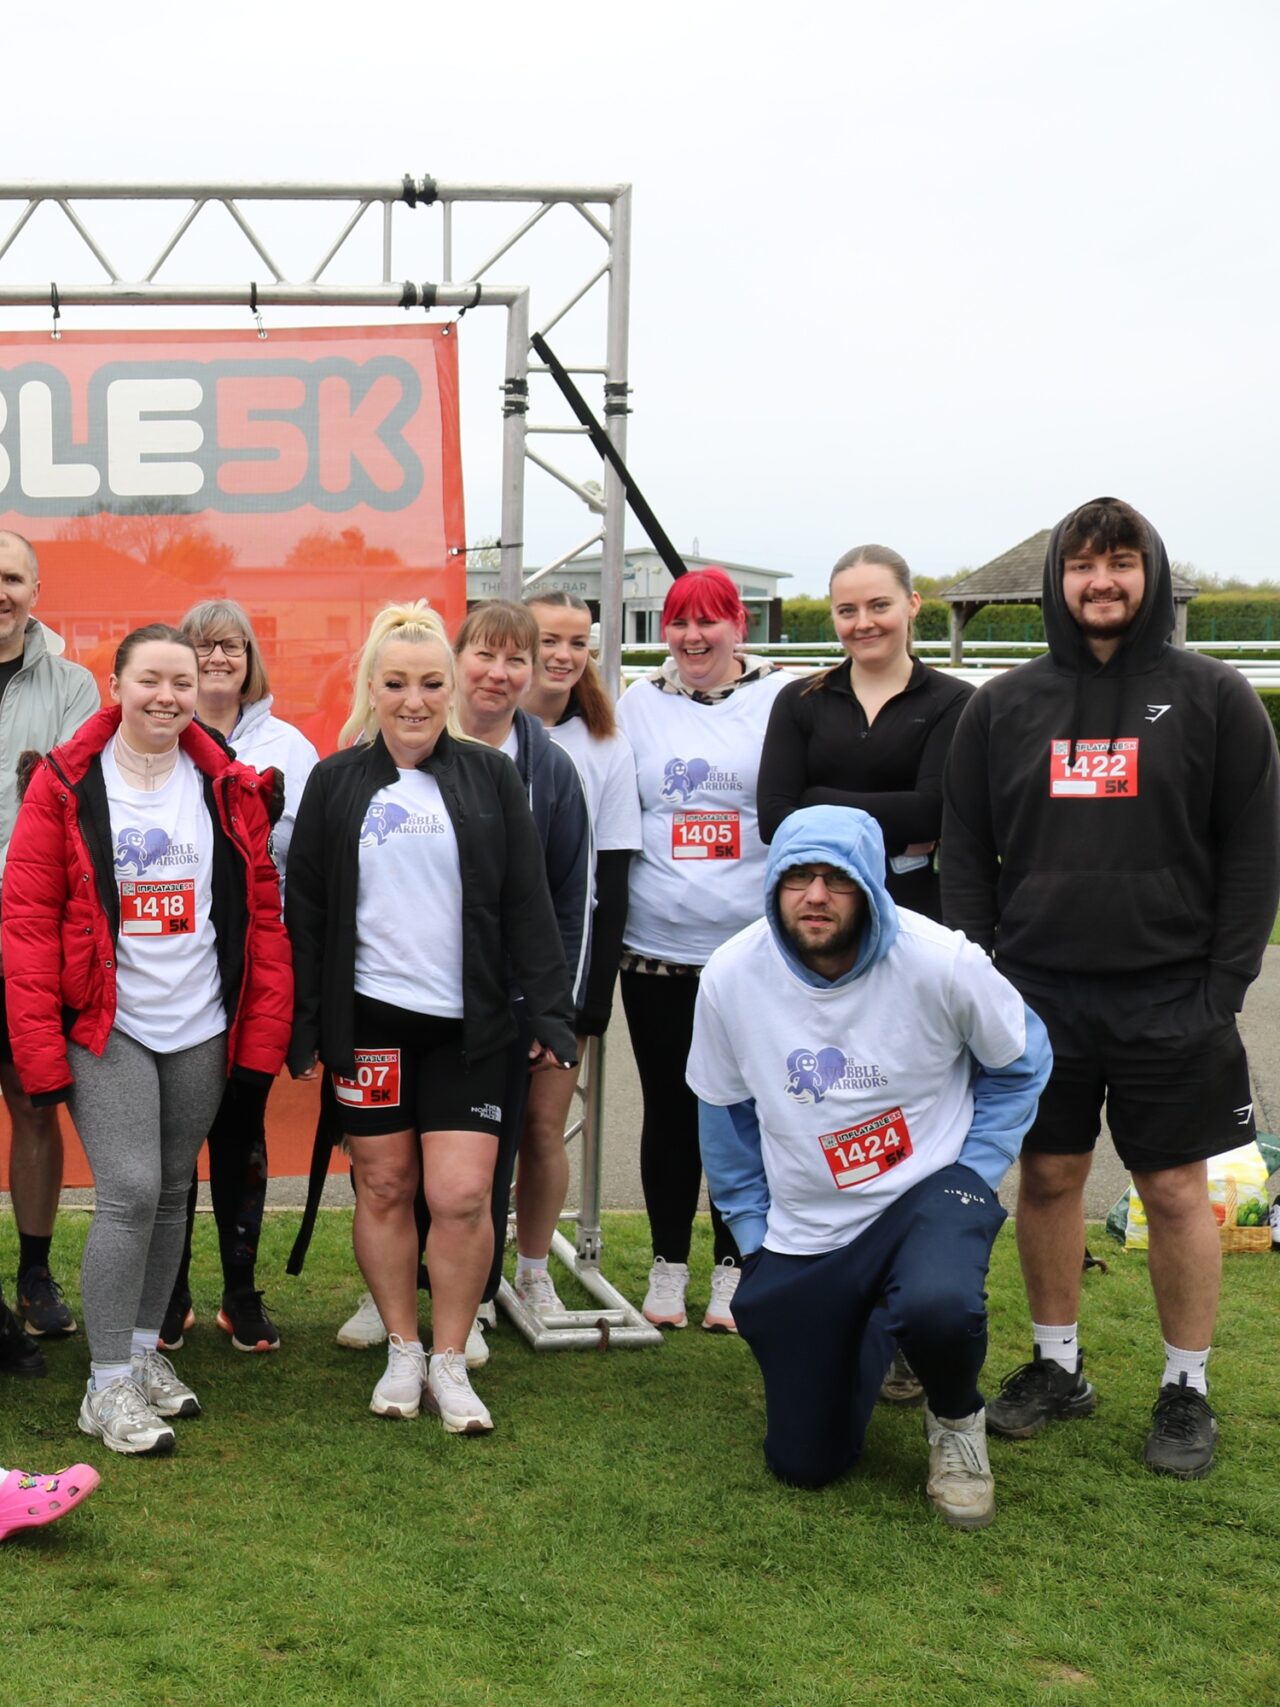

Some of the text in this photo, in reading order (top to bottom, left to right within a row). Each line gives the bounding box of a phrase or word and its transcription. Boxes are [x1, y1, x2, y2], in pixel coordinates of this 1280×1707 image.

[563, 582, 588, 592] BAR
[1061, 754, 1127, 778] 1422
[1105, 780, 1128, 794] 5K
[679, 824, 732, 844] 1405
[715, 845, 734, 858] 5K
[133, 895, 185, 918] 1418
[169, 918, 189, 932] 5K
[371, 1089, 391, 1102] 5K
[834, 1127, 900, 1168] 1424
[885, 1147, 907, 1166] 5K
